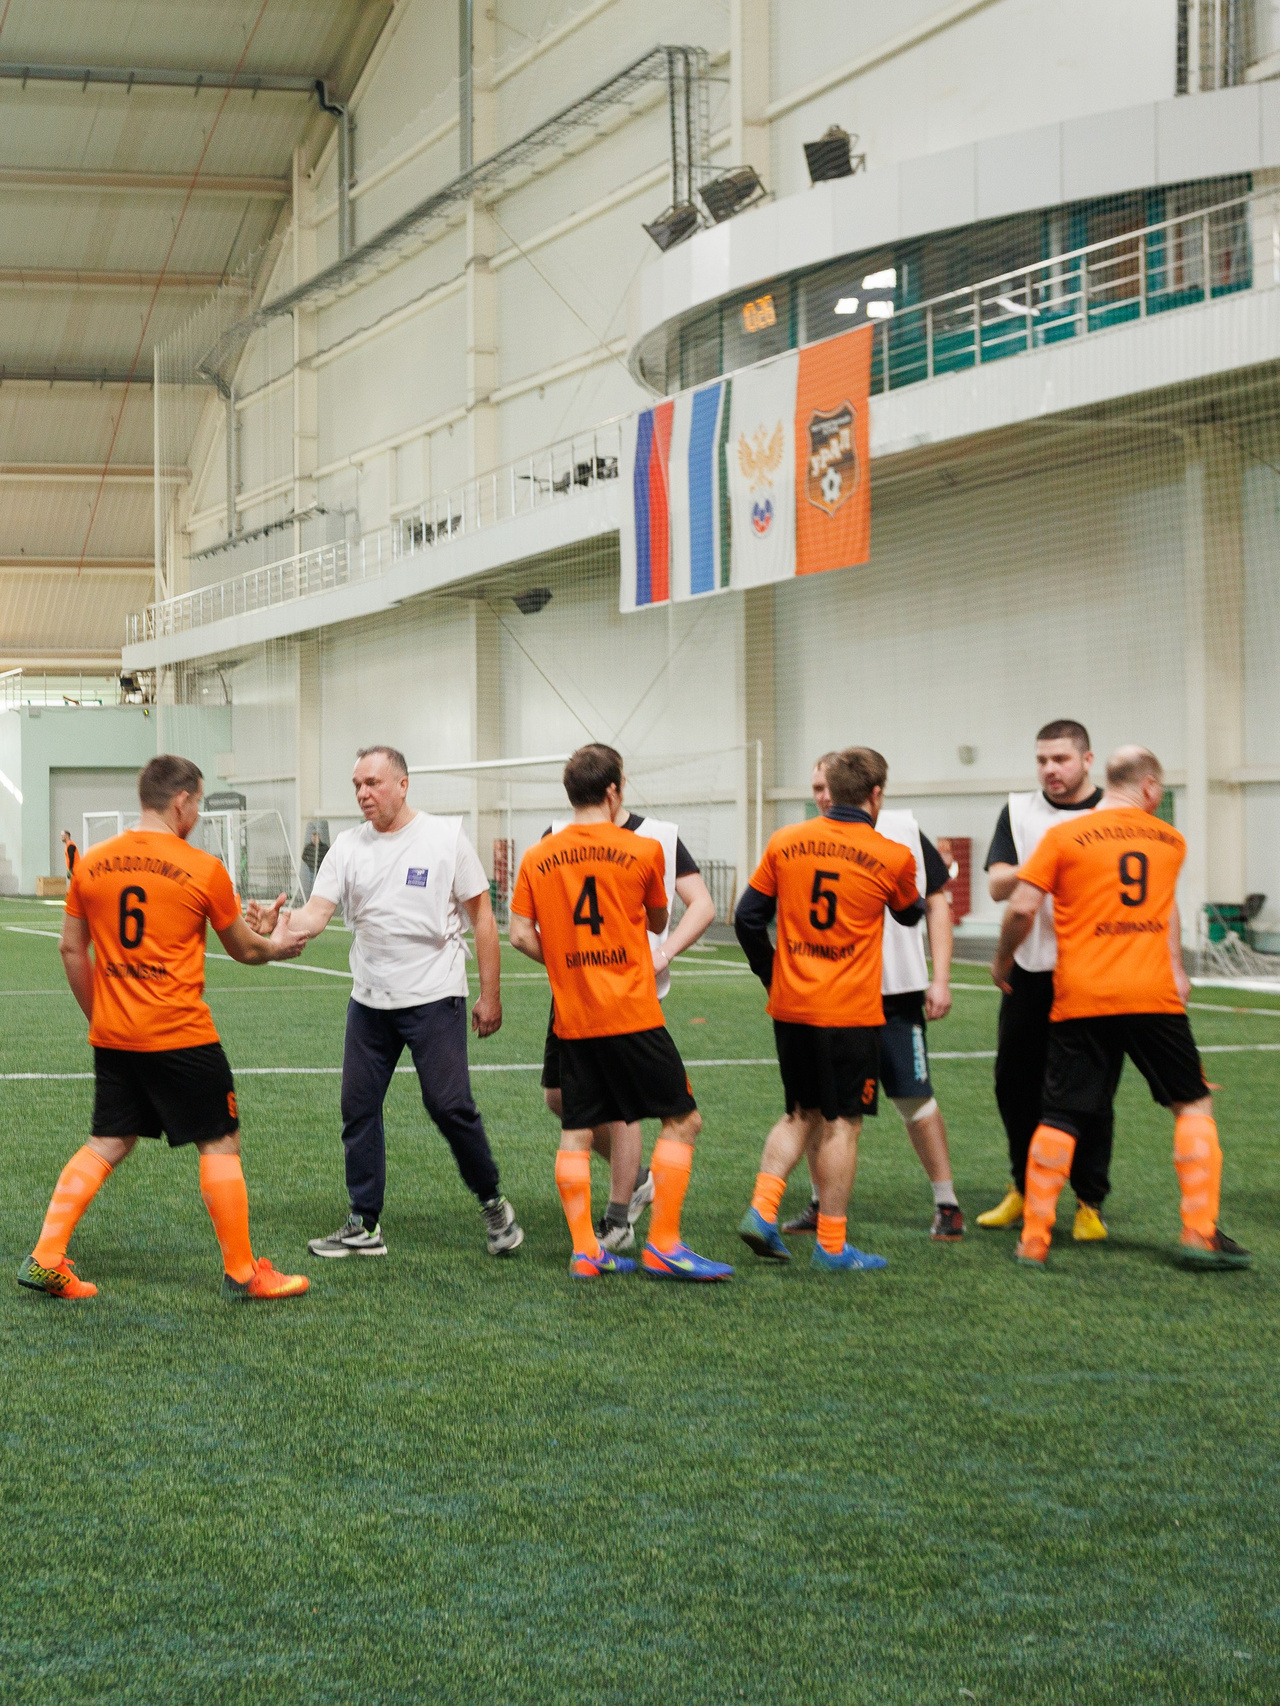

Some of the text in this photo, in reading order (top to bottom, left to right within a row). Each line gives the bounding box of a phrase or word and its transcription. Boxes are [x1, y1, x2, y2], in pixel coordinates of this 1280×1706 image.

[810, 427, 851, 478] УРАЛ
[536, 845, 638, 876] УРАЛДОЛОМИТ
[782, 839, 886, 875] УРАЛДОЛОМИТ
[1118, 851, 1149, 907] 9
[120, 885, 147, 949] 6
[573, 875, 605, 936] 4
[809, 869, 840, 930] 5
[861, 1078, 876, 1105] 5
